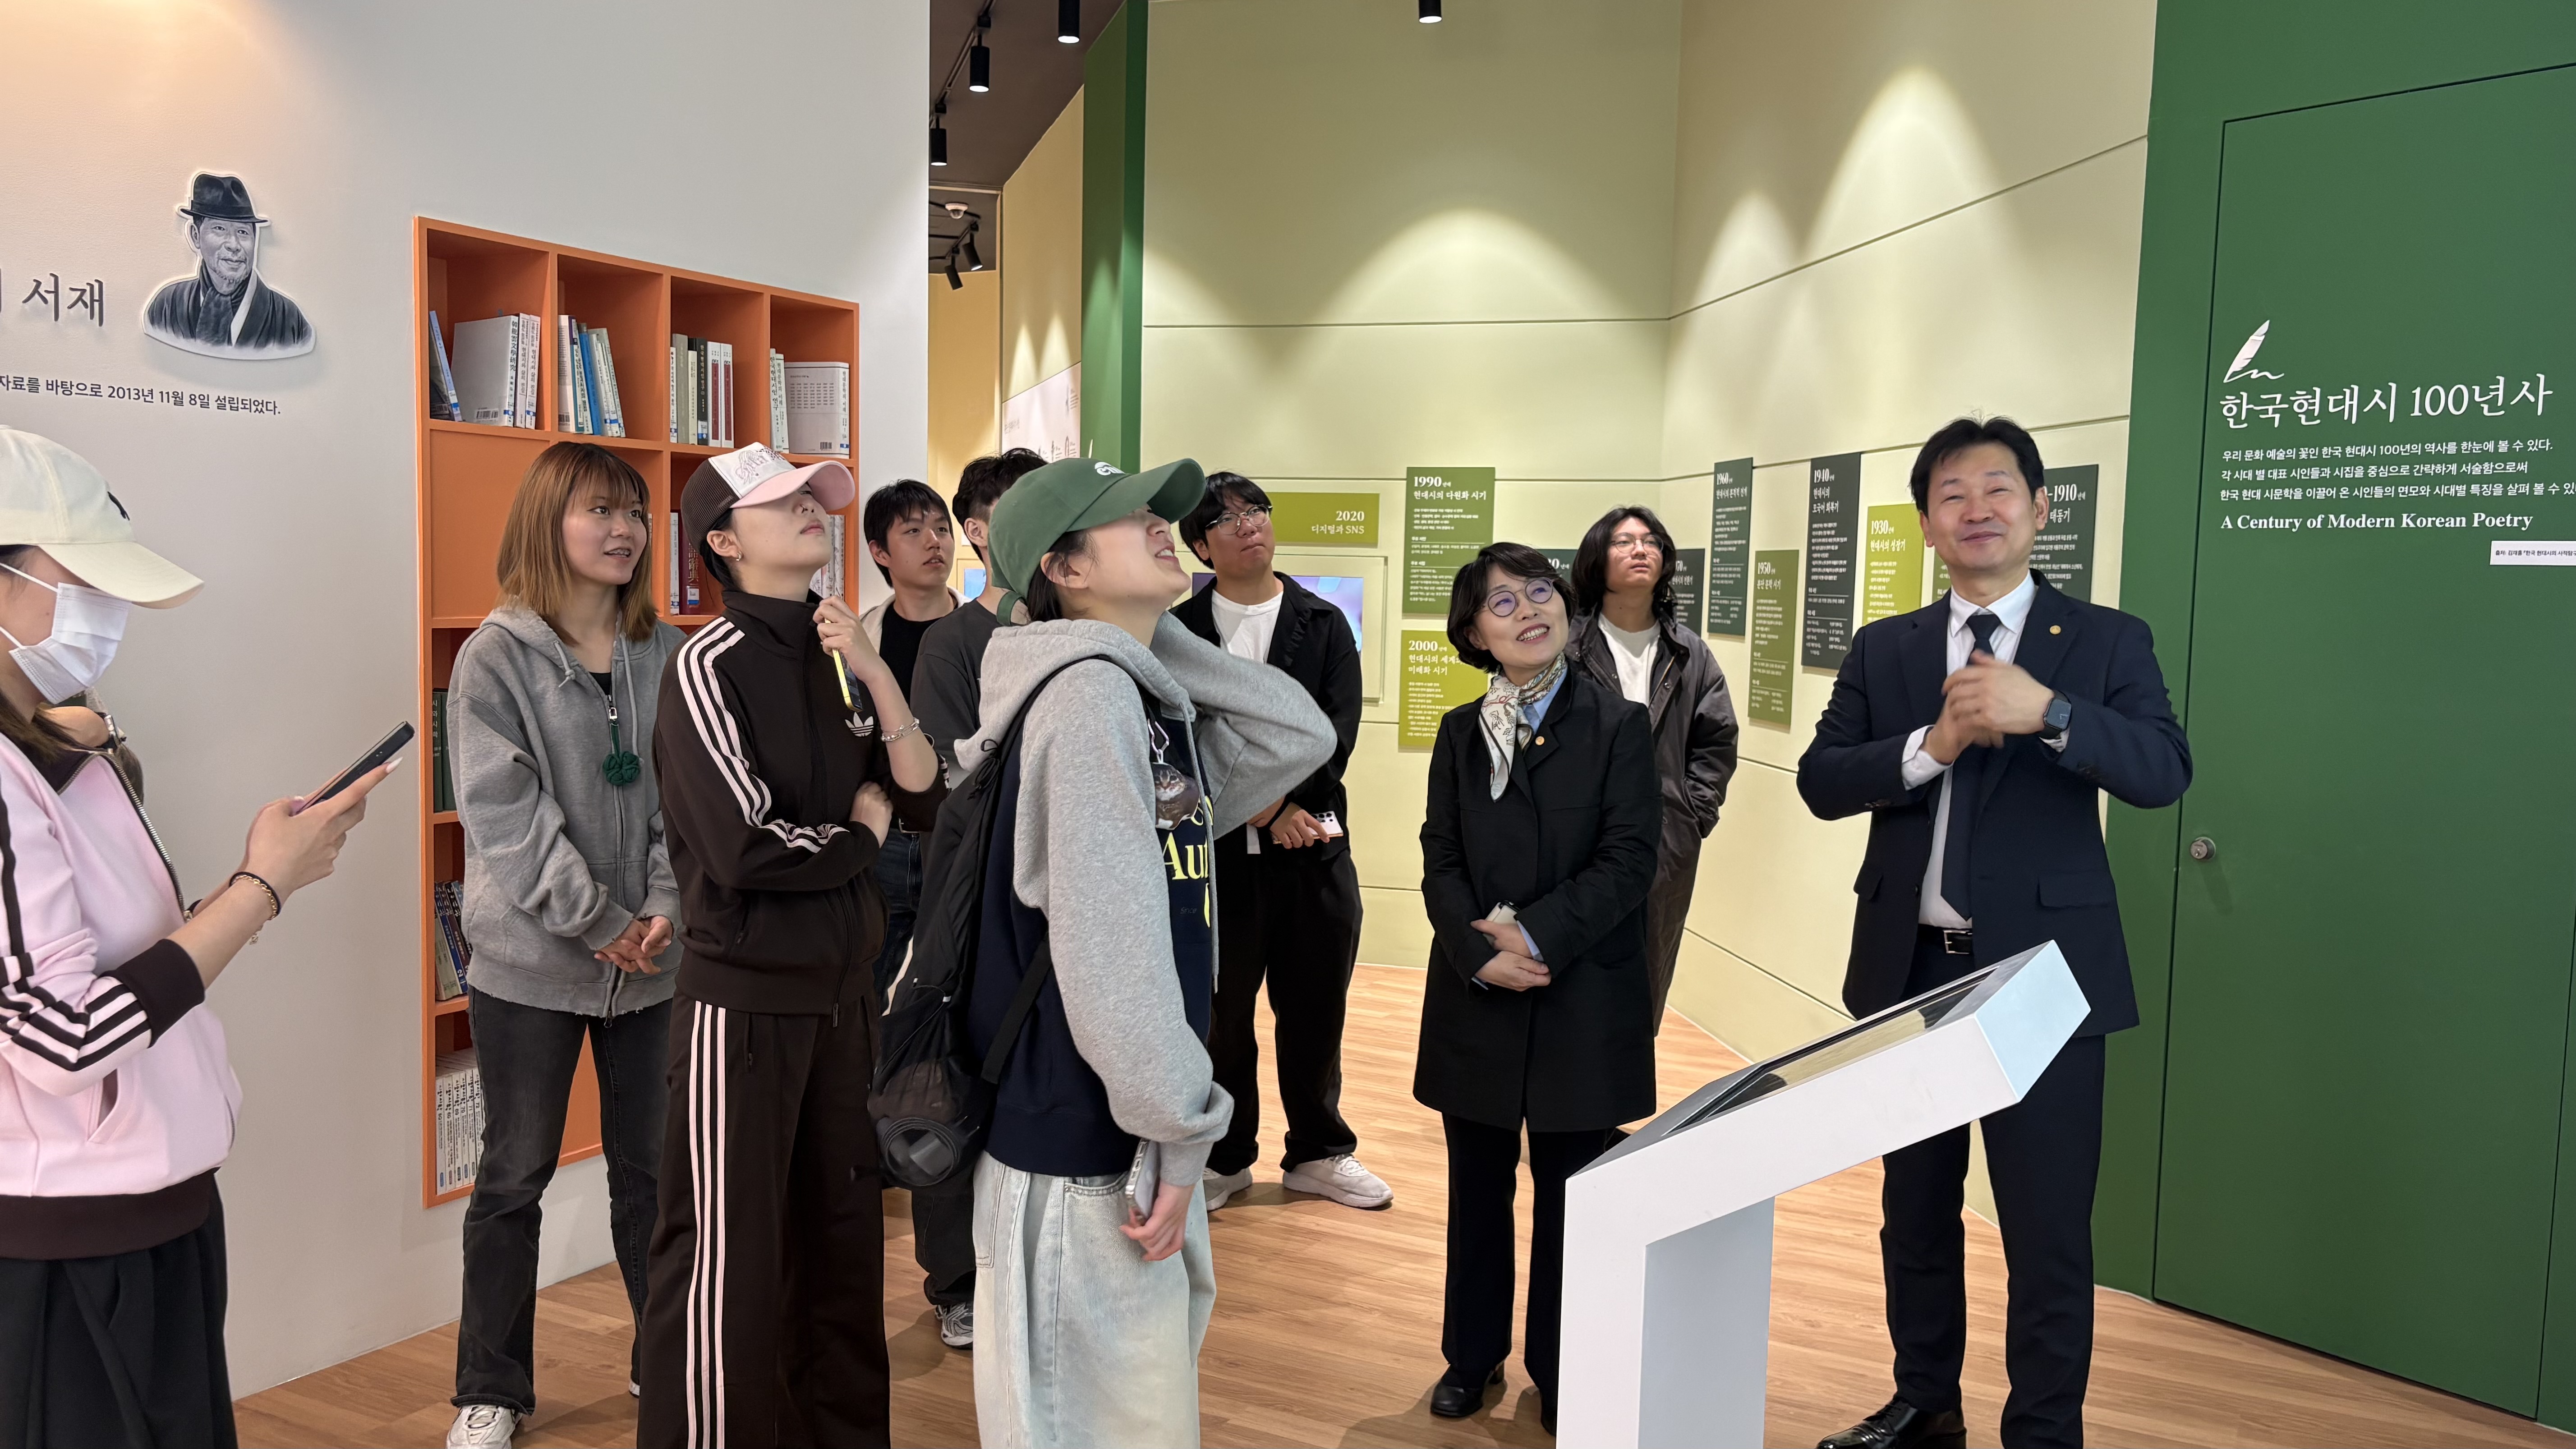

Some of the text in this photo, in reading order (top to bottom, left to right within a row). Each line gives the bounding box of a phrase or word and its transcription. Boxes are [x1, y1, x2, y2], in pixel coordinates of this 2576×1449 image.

[23, 273, 103, 327] 서재
[0, 375, 280, 415] 자료를 바탕으로 2013년 11월 8일 설립되었다.
[2220, 373, 2553, 428] 한국현대시 100년사
[2223, 439, 2553, 461] 우리 문화 예술의 꽃인 한국 현대시 100년의 역사를 한눈에 볼 수 있다.
[2222, 461, 2527, 481] 각 시대 별 대표 시인들과 시집을 중심으로 간략하게 서술함으로써
[1414, 491, 1486, 500] 현대시의 다원화 시기
[2221, 482, 2576, 501] 한국 현대 시문학을 이끌어 온 시인들의 면모와 시대별 특징을 살펴 볼 수 있
[1336, 511, 1364, 521] 2020
[2050, 508, 2070, 523] 태동기
[2221, 513, 2533, 532] A Century of Modern Korean Poetry
[1312, 524, 1364, 534] 디지털과 SNS
[1409, 655, 1438, 663] 현대시의
[1408, 666, 1448, 675] 미래화 시기
